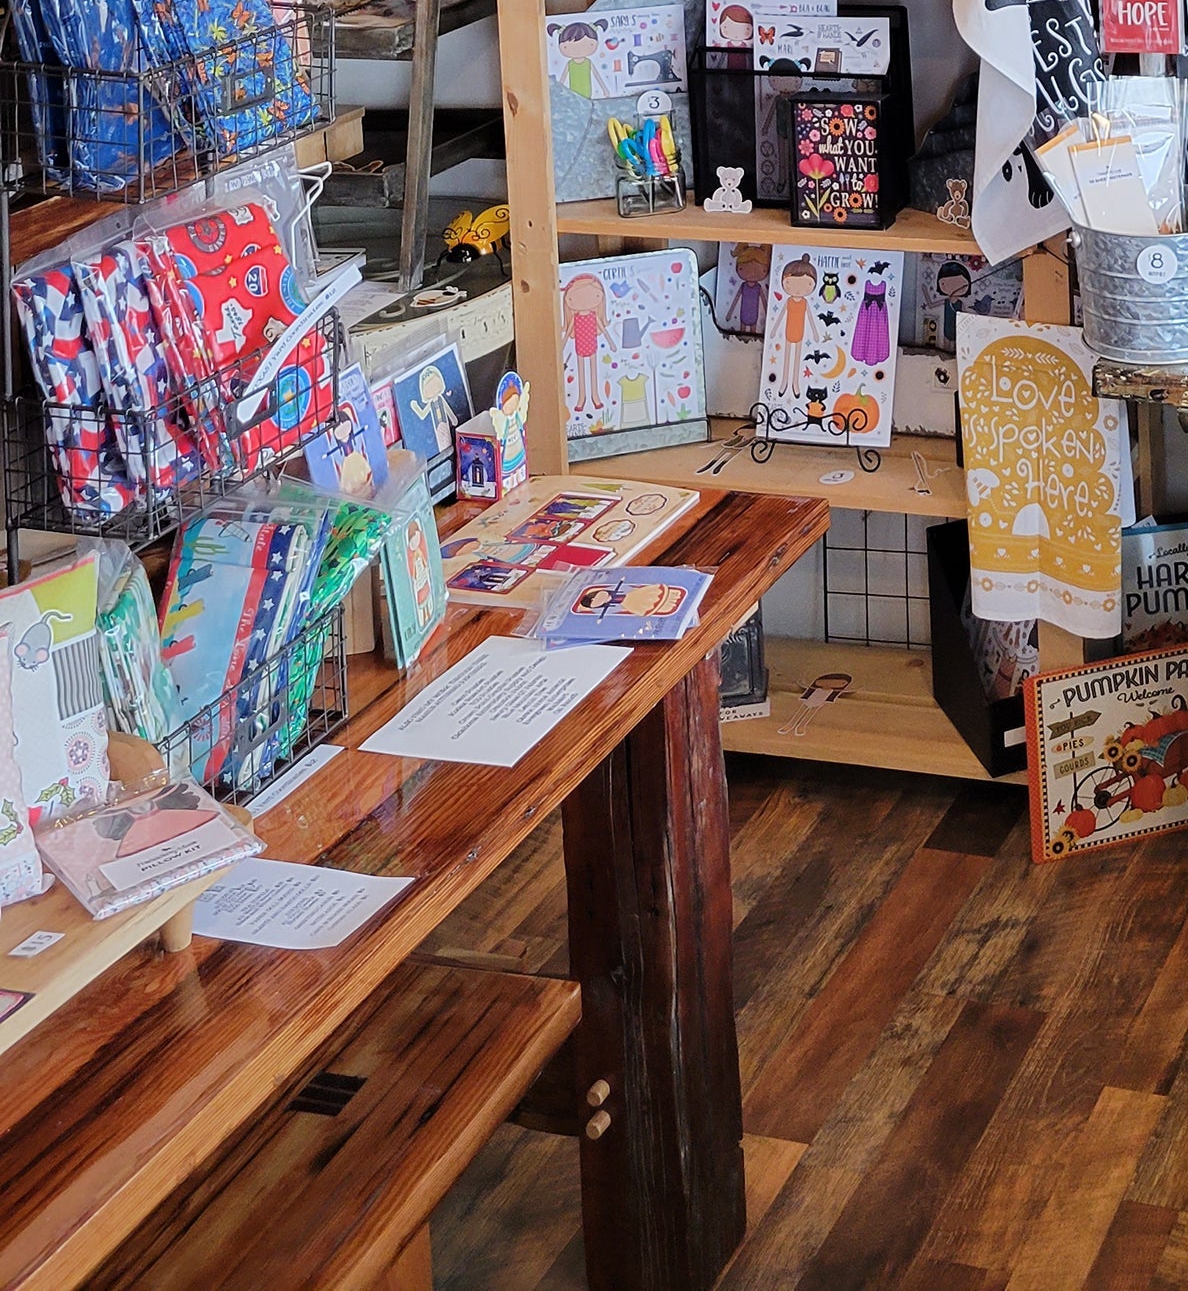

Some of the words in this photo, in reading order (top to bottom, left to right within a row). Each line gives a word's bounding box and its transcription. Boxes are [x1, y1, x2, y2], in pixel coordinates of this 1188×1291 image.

[1118, 2, 1168, 26] HOPE
[818, 135, 844, 155] what
[844, 140, 875, 155] YOU
[834, 156, 877, 172] WANT
[851, 173, 863, 191] to
[830, 191, 878, 208] GROW!
[246, 272, 256, 292] 20
[989, 416, 1095, 464] spoken
[1062, 663, 1160, 708] PUMPKIN
[1117, 686, 1175, 703] Welcome
[1063, 738, 1085, 750] PIES
[1060, 758, 1089, 775] GOURDS
[140, 850, 183, 873] PILLOW
[184, 844, 202, 855] KIT
[20, 933, 54, 955] $15
